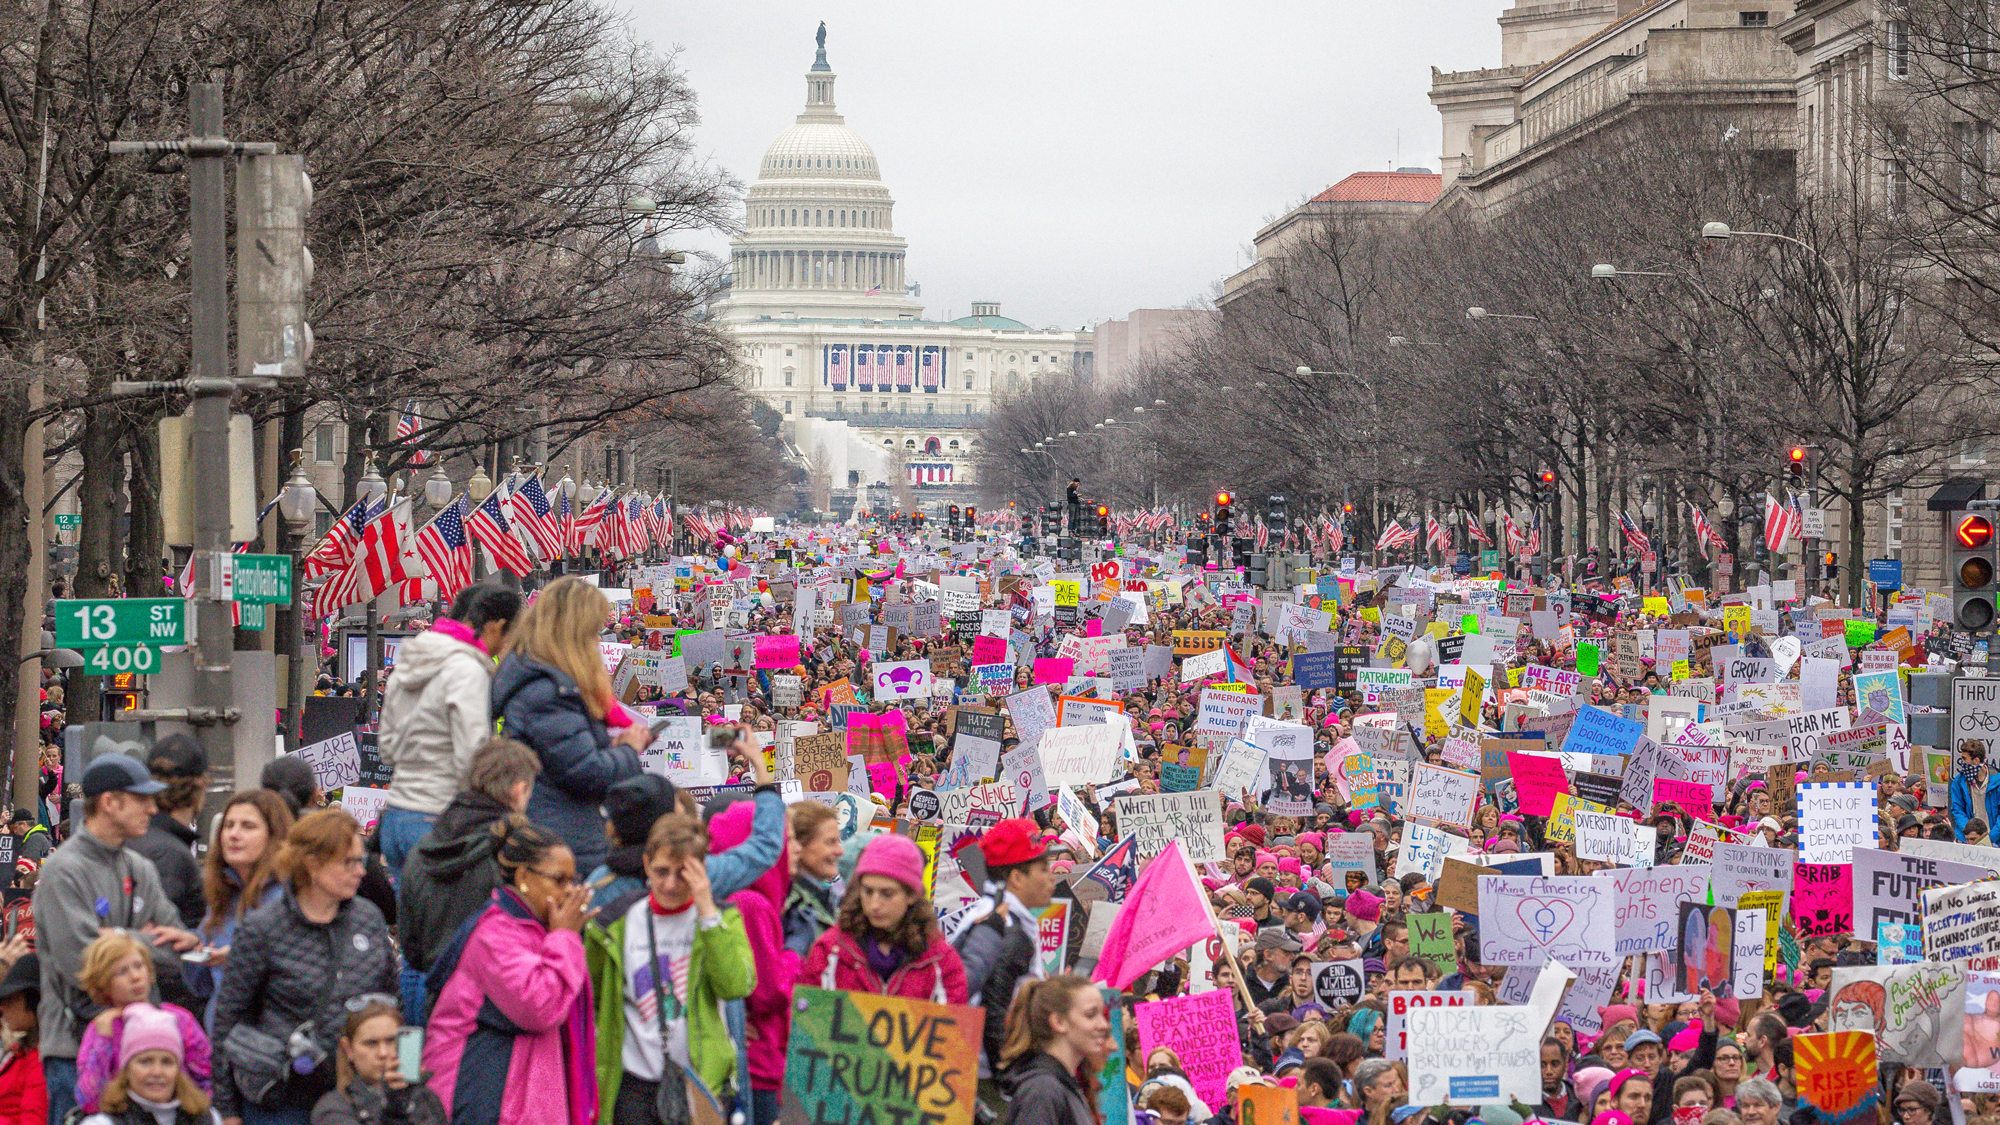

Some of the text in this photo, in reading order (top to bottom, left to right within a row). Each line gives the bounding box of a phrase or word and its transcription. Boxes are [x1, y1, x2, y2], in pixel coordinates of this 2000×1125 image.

[1092, 561, 1119, 582] HO
[243, 605, 262, 626] 1300
[956, 611, 982, 620] RESIST
[1286, 605, 1321, 620] WE NEED
[74, 606, 174, 640] 13 ST
[150, 622, 177, 637] NW
[1387, 618, 1413, 629] GRAB
[1173, 636, 1224, 648] RESIST
[1665, 638, 1681, 646] THE
[1694, 633, 1728, 648] LOVE
[1658, 644, 1688, 654] FUTURE
[92, 648, 152, 670] 400
[1111, 662, 1142, 671] DIVERSITY
[1186, 653, 1218, 667] RAISED
[977, 665, 1013, 673] FREEDOM
[982, 671, 1011, 680] SPEECH
[1528, 667, 1580, 685] WE ARE
[980, 678, 1013, 686] WORSHIP
[1359, 672, 1411, 684] PATRIARCHY
[991, 684, 1012, 692] WANT
[1536, 678, 1572, 695] BETTER
[1959, 685, 1997, 701] THRU
[1207, 693, 1258, 705] AMERICANS
[1737, 701, 1753, 709] LONGER
[1205, 705, 1225, 714] WILL
[1228, 707, 1244, 716] NOT
[968, 715, 990, 727] HATE
[1209, 717, 1237, 727] RULED
[1584, 710, 1626, 732] checks
[1789, 712, 1841, 734] HEAR ME
[778, 723, 797, 738] THE
[1828, 727, 1876, 745] WOMEN
[323, 734, 354, 758] ARE
[796, 733, 845, 748] RESPETA MI
[1354, 727, 1409, 754] WHEN SHE
[1578, 726, 1629, 751] balances
[796, 744, 842, 755] EXISTENCIA
[814, 751, 842, 762] ESPERA
[1702, 749, 1729, 765] TINY
[1736, 746, 1748, 754] We
[313, 758, 335, 771] THE
[668, 761, 694, 769] WALL
[795, 758, 847, 774] RESISTENCIA
[1775, 764, 1792, 777] WHAT
[1377, 769, 1394, 781] I'M
[1692, 769, 1725, 785] OFF MY
[915, 794, 937, 805] RESPECT
[1417, 788, 1443, 799] GREED
[348, 797, 368, 806] HEAR
[1119, 798, 1156, 816] WHEN
[1189, 796, 1208, 810] THE
[1568, 796, 1597, 812] OF THE
[1810, 798, 1861, 810] MEN OF
[1120, 812, 1185, 828] DOLLAR
[1576, 814, 1630, 834] DIVERSITY IS
[1809, 818, 1862, 831] QUALITY
[1411, 825, 1452, 854] Liberty
[1810, 834, 1863, 846] DEMAND
[1584, 835, 1635, 864] beautiful
[1724, 849, 1786, 867] STOP TRYING
[1737, 866, 1768, 876] CONTROL
[1796, 863, 1841, 883] GRAB
[1901, 857, 1937, 876] THE
[1486, 878, 1601, 896] Making America
[1614, 871, 1704, 895] Women's
[1417, 919, 1445, 942] We
[1578, 951, 1611, 962] 1776
[1329, 965, 1345, 977] END
[1196, 994, 1227, 1007] TRUE
[1152, 1006, 1230, 1030] GREATNESS
[1411, 1011, 1482, 1036] GOLDEN
[828, 997, 956, 1059] LOVE
[1153, 1019, 1232, 1043] OF A NATION
[1413, 1034, 1489, 1054] SHOWERS
[1415, 1052, 1461, 1069] BRING
[799, 1048, 961, 1108] TRUMPS
[1812, 1069, 1858, 1091] RISE
